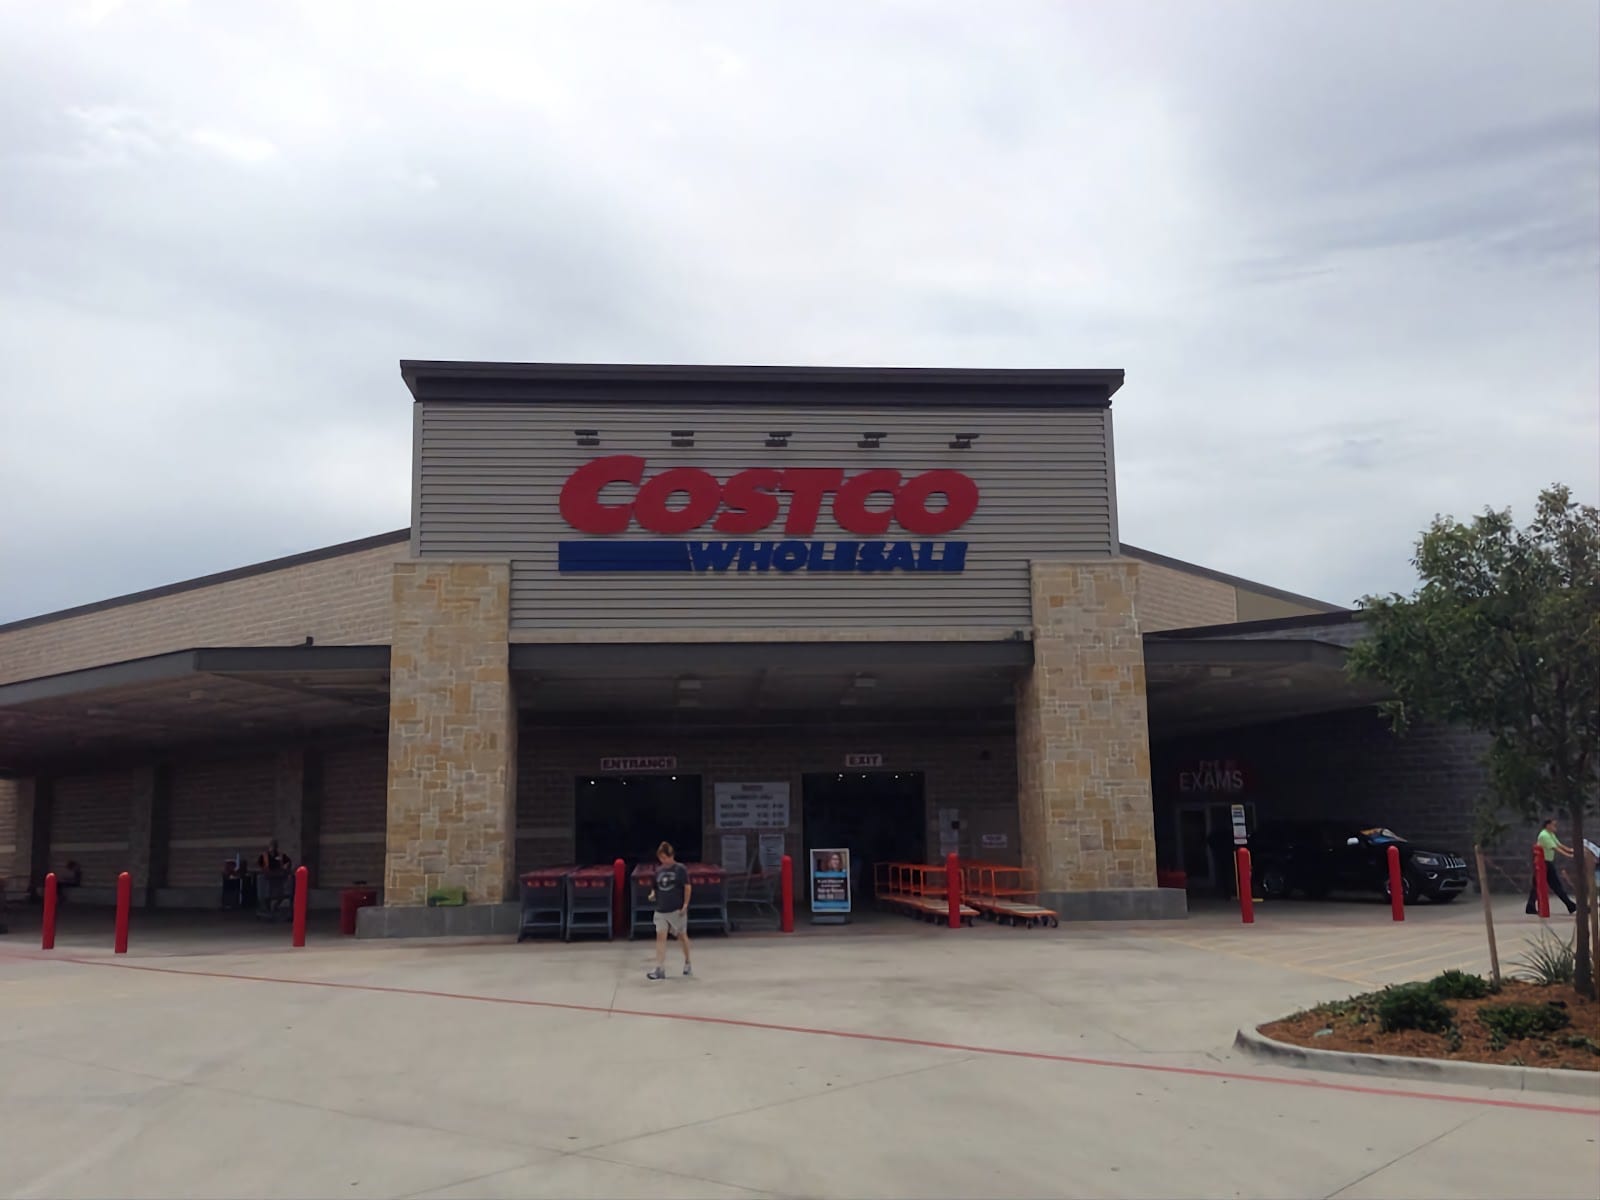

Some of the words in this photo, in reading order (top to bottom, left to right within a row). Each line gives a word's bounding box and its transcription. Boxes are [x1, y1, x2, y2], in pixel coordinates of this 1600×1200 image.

[559, 454, 980, 537] COSTCO
[688, 541, 969, 573] WHOLESALE
[602, 758, 675, 769] ENTRANCE
[849, 755, 880, 766] EXIT
[1179, 769, 1245, 791] EXAMS
